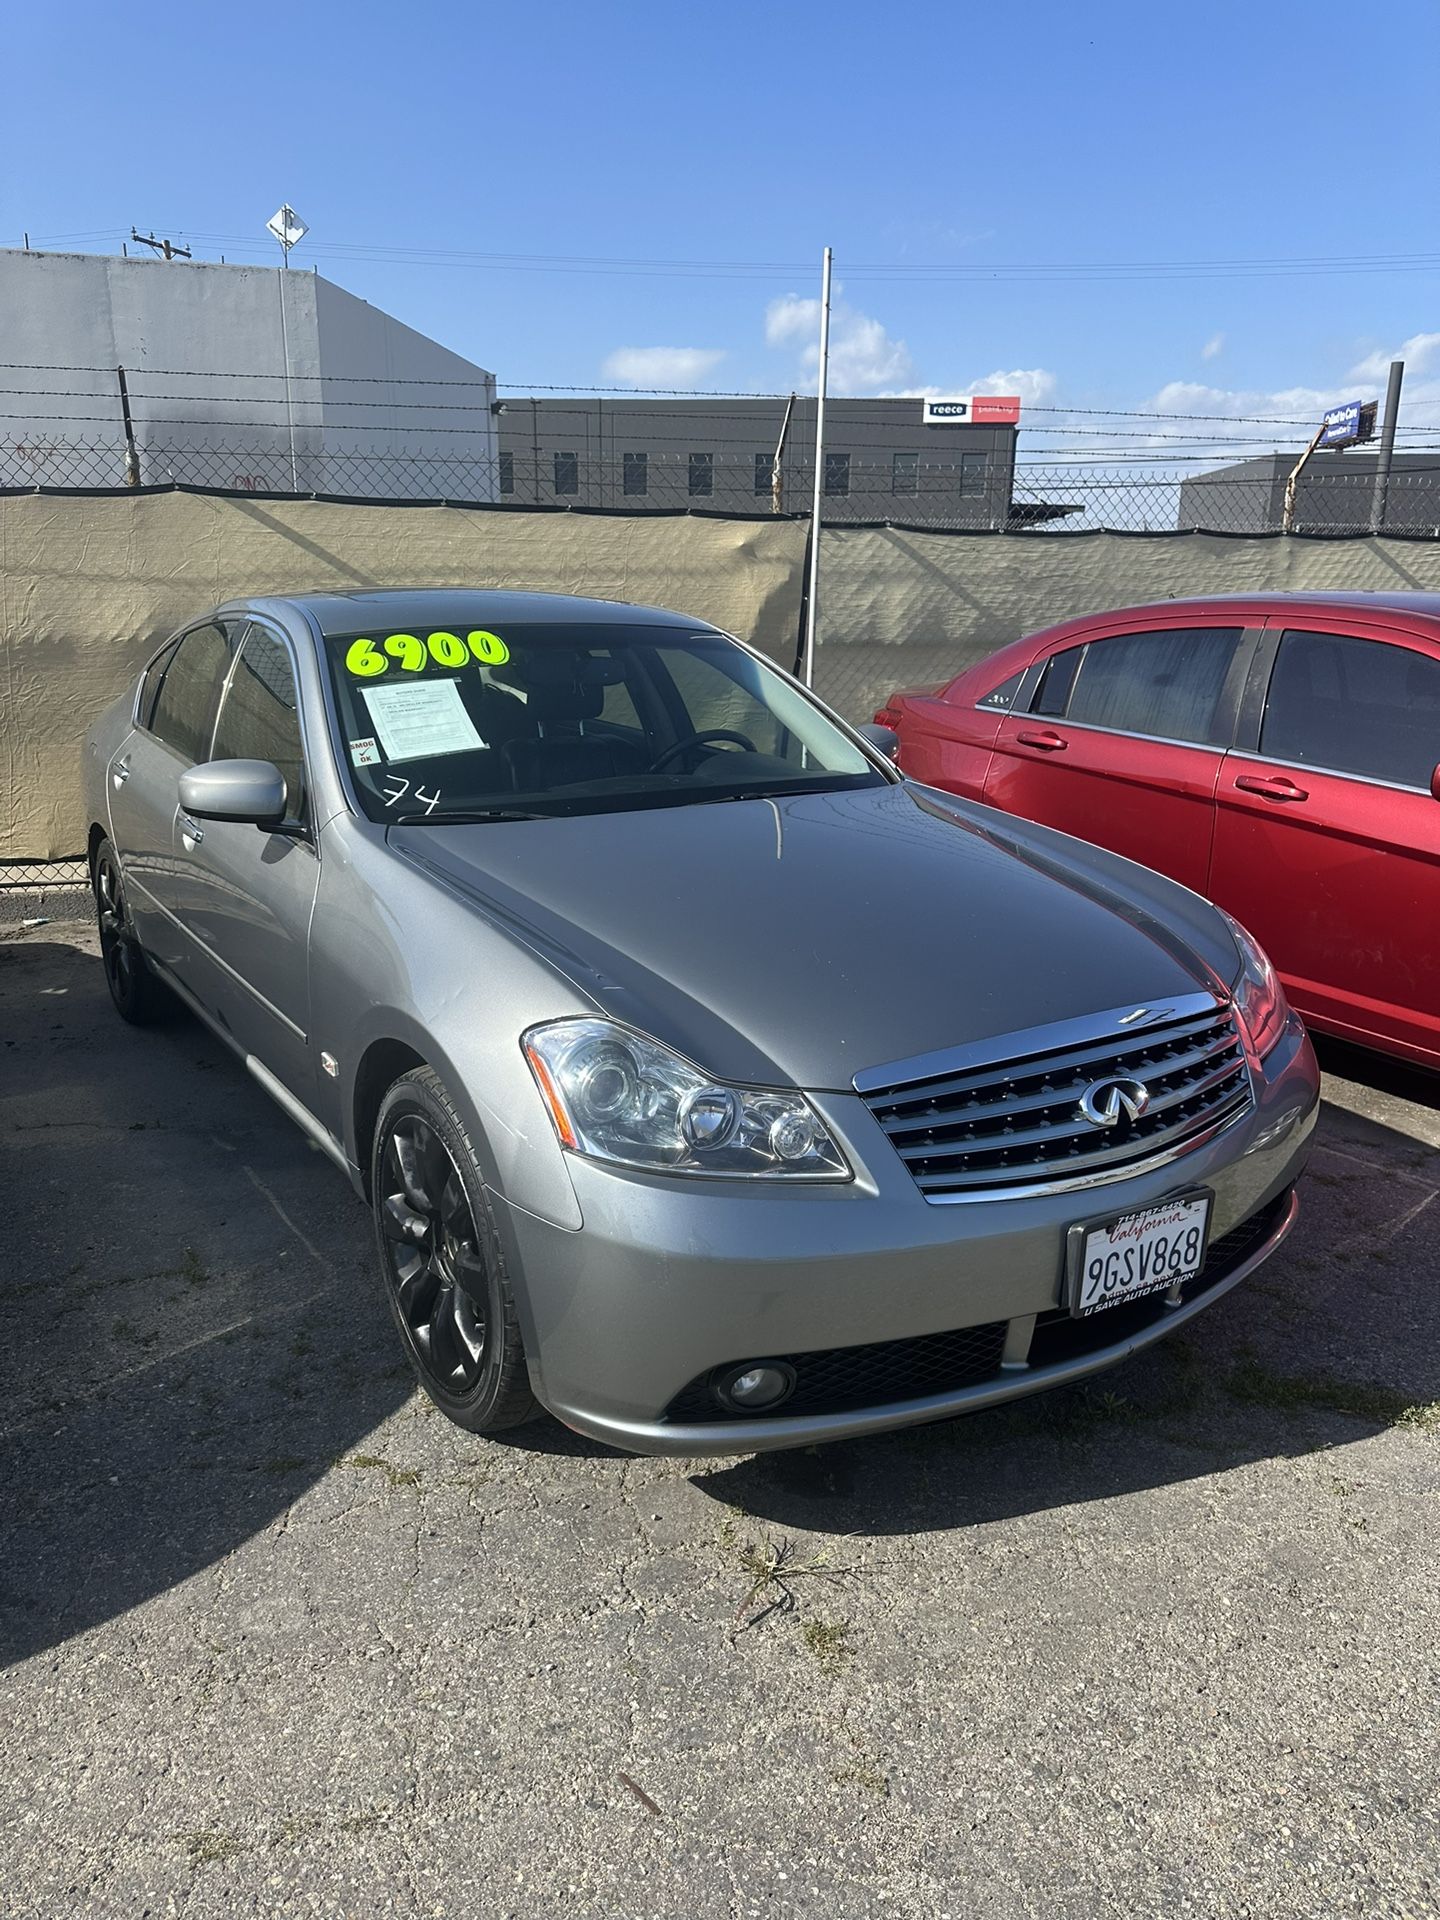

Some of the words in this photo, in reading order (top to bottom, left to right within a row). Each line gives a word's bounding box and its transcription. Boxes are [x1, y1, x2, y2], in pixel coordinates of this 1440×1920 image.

[933, 406, 964, 414] reece
[346, 630, 510, 677] 6900
[350, 741, 374, 750] SMOG
[360, 755, 373, 763] OK
[383, 774, 441, 816] 74
[1109, 1211, 1188, 1244] California
[1086, 1226, 1200, 1301] 9GSV868
[1084, 1307, 1093, 1317] U
[1094, 1297, 1122, 1313] SAVE
[1123, 1287, 1151, 1303] AUTO
[1152, 1271, 1196, 1292] AUCTION
